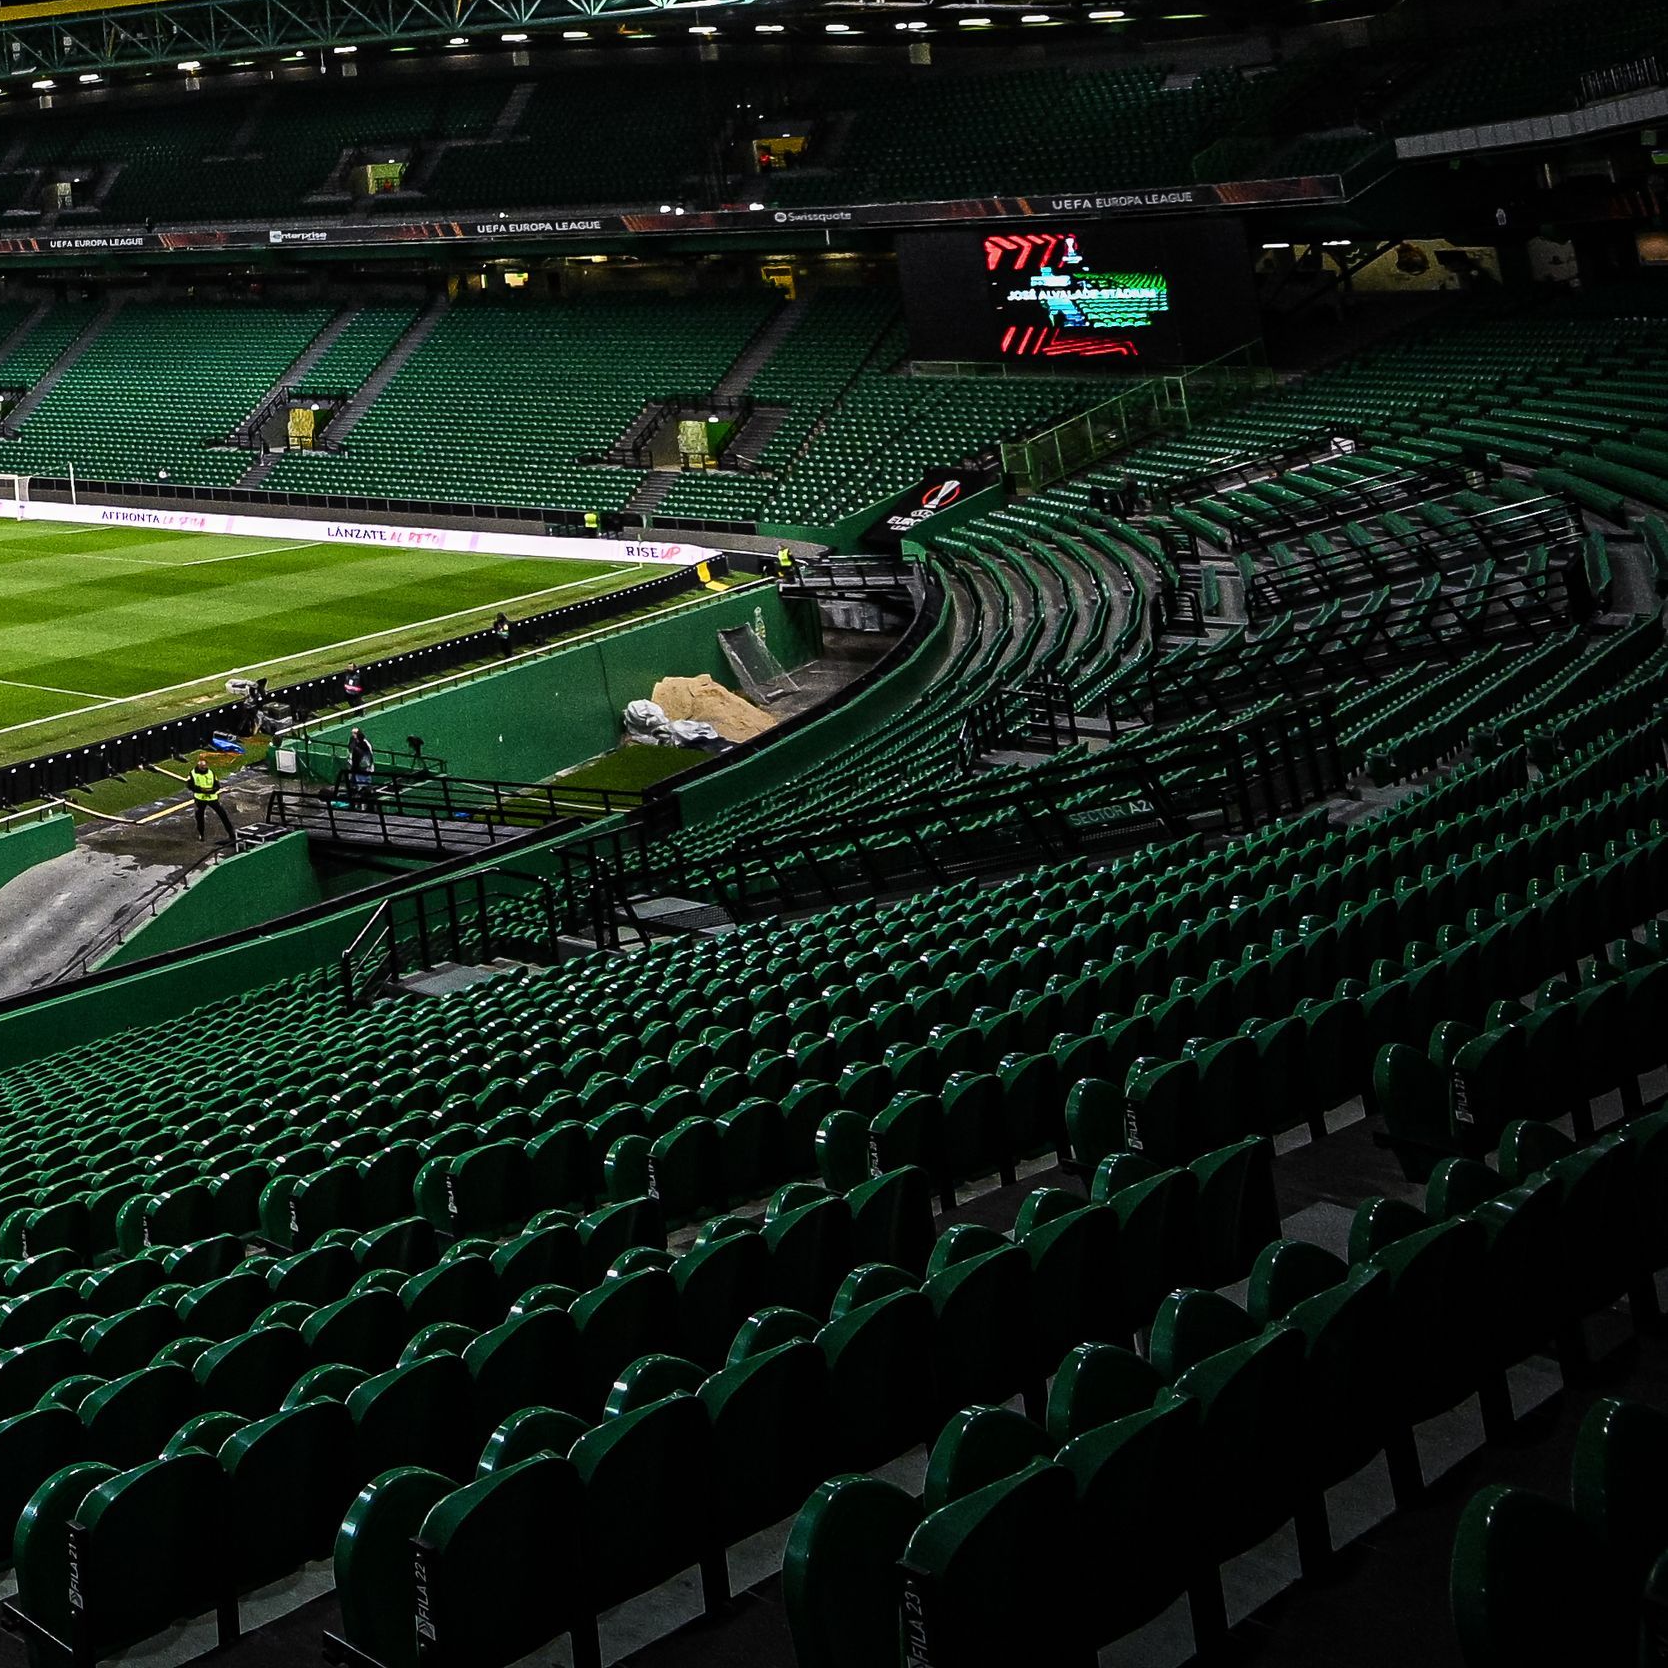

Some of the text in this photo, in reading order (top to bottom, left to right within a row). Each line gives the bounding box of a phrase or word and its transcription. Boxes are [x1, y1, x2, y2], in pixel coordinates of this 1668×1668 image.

[1052, 192, 1193, 210] UEFA EUROPA LEAGUE
[477, 221, 601, 233] UEFA EUROPA LEAGUE
[50, 238, 143, 248] UEFA EUROPA LEAGUE
[327, 526, 387, 541] LÁNZATE
[626, 546, 659, 558] RISE
[1069, 799, 1154, 825] SECTOR A2
